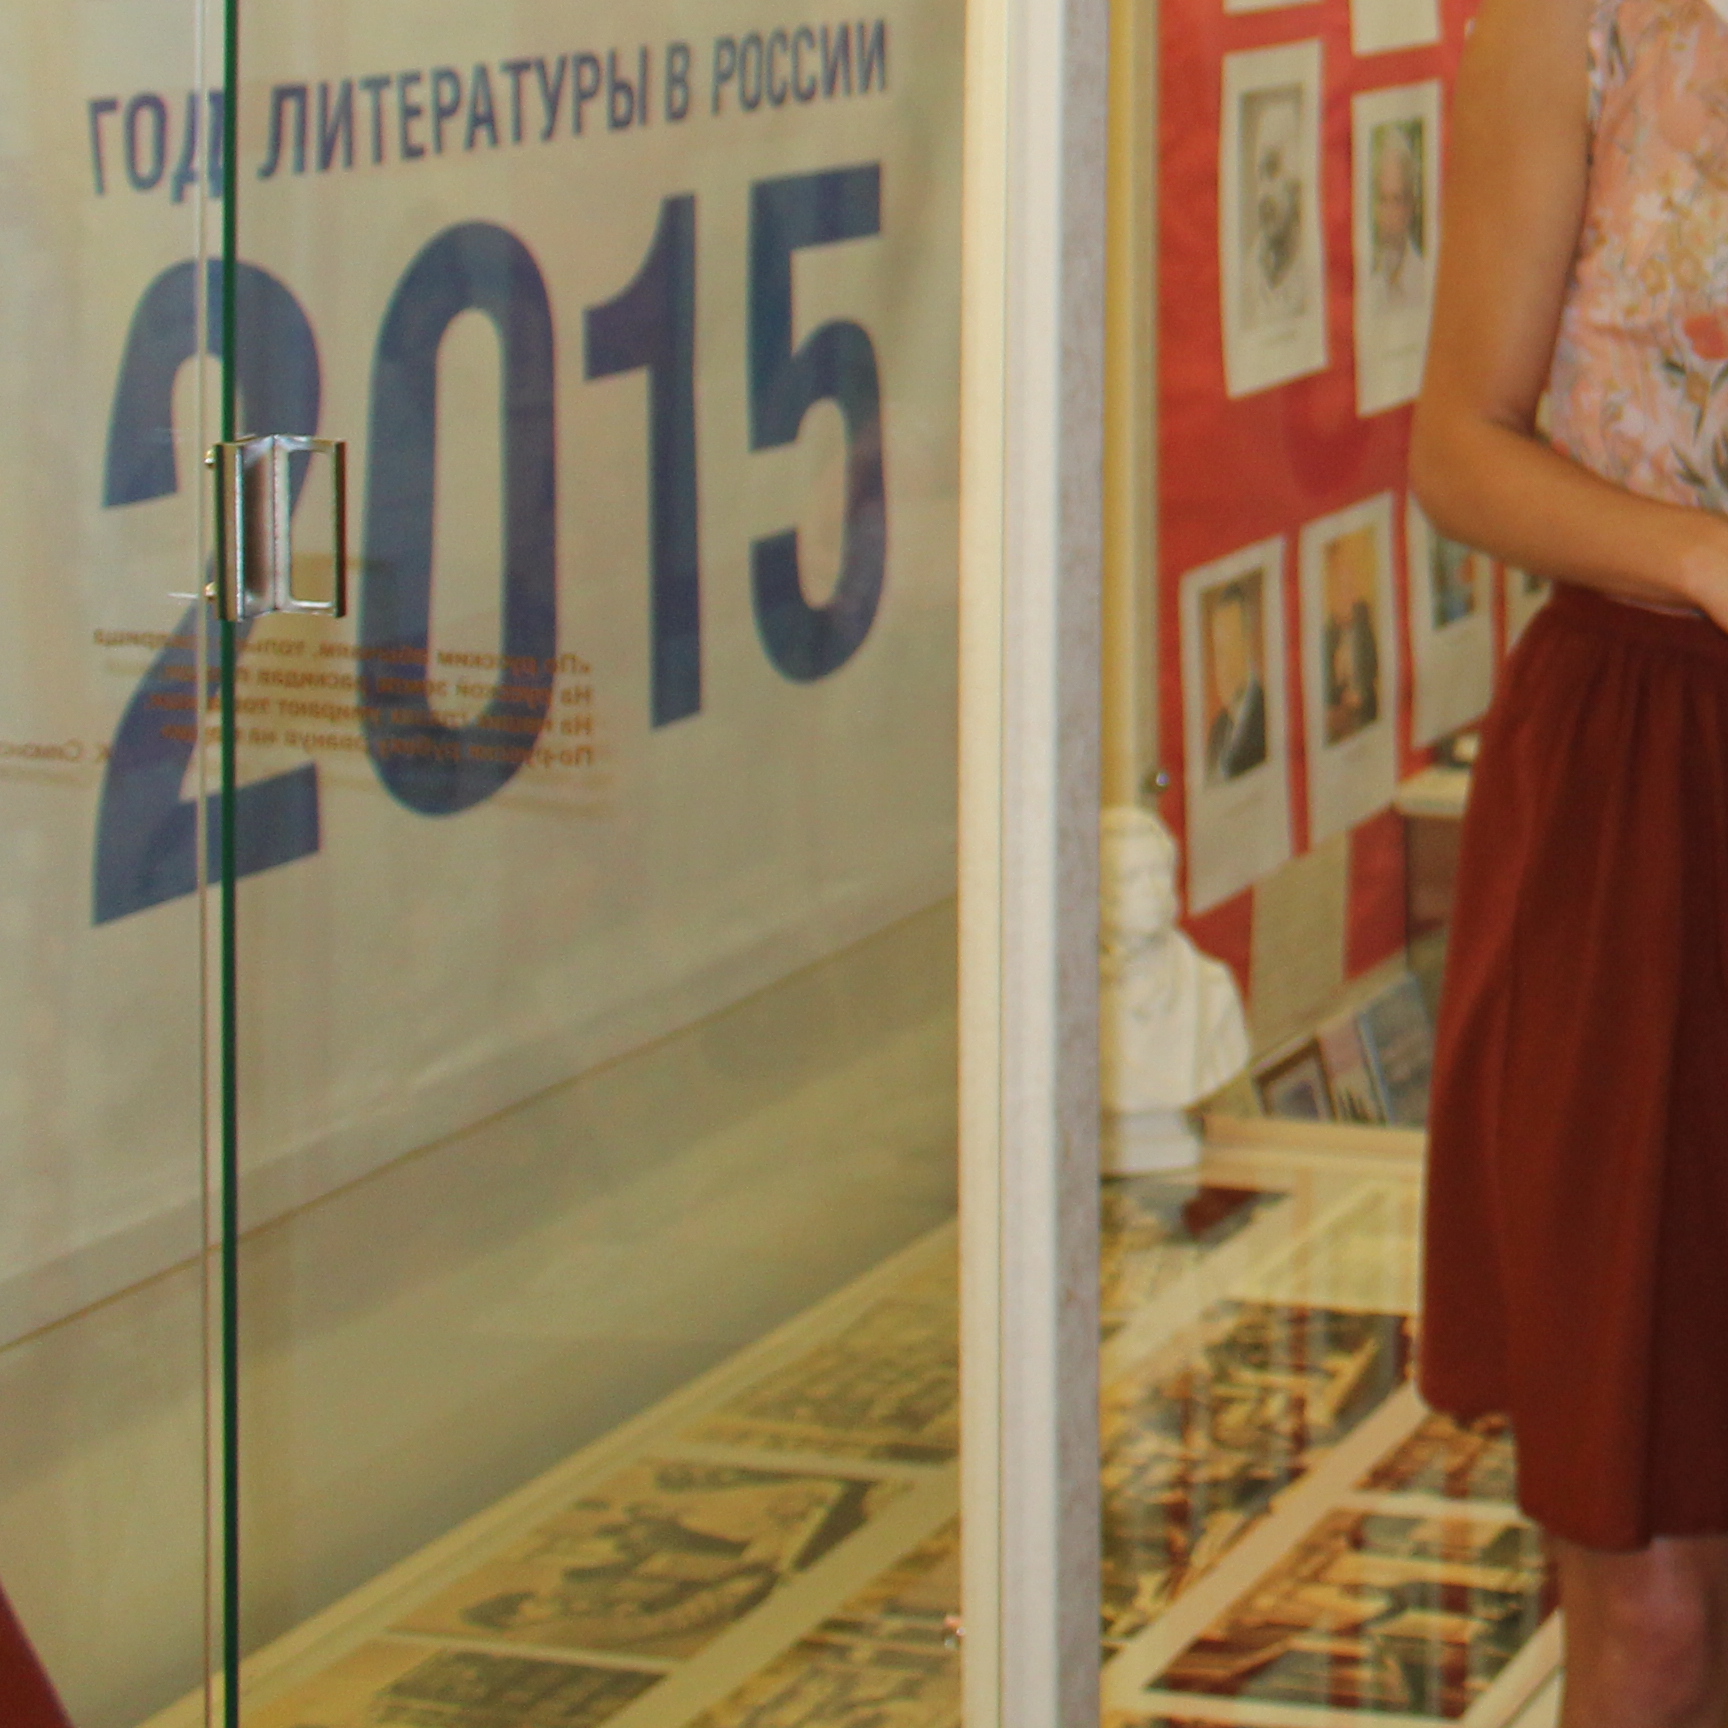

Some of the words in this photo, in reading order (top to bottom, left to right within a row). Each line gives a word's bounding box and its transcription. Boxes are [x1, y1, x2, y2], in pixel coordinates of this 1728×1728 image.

[87, 89, 229, 205] ГОД
[256, 43, 649, 181] ЛИТЕРАТУРЫ
[665, 39, 693, 123] В
[710, 17, 888, 117] РОССИИ
[91, 160, 889, 927] 2015
